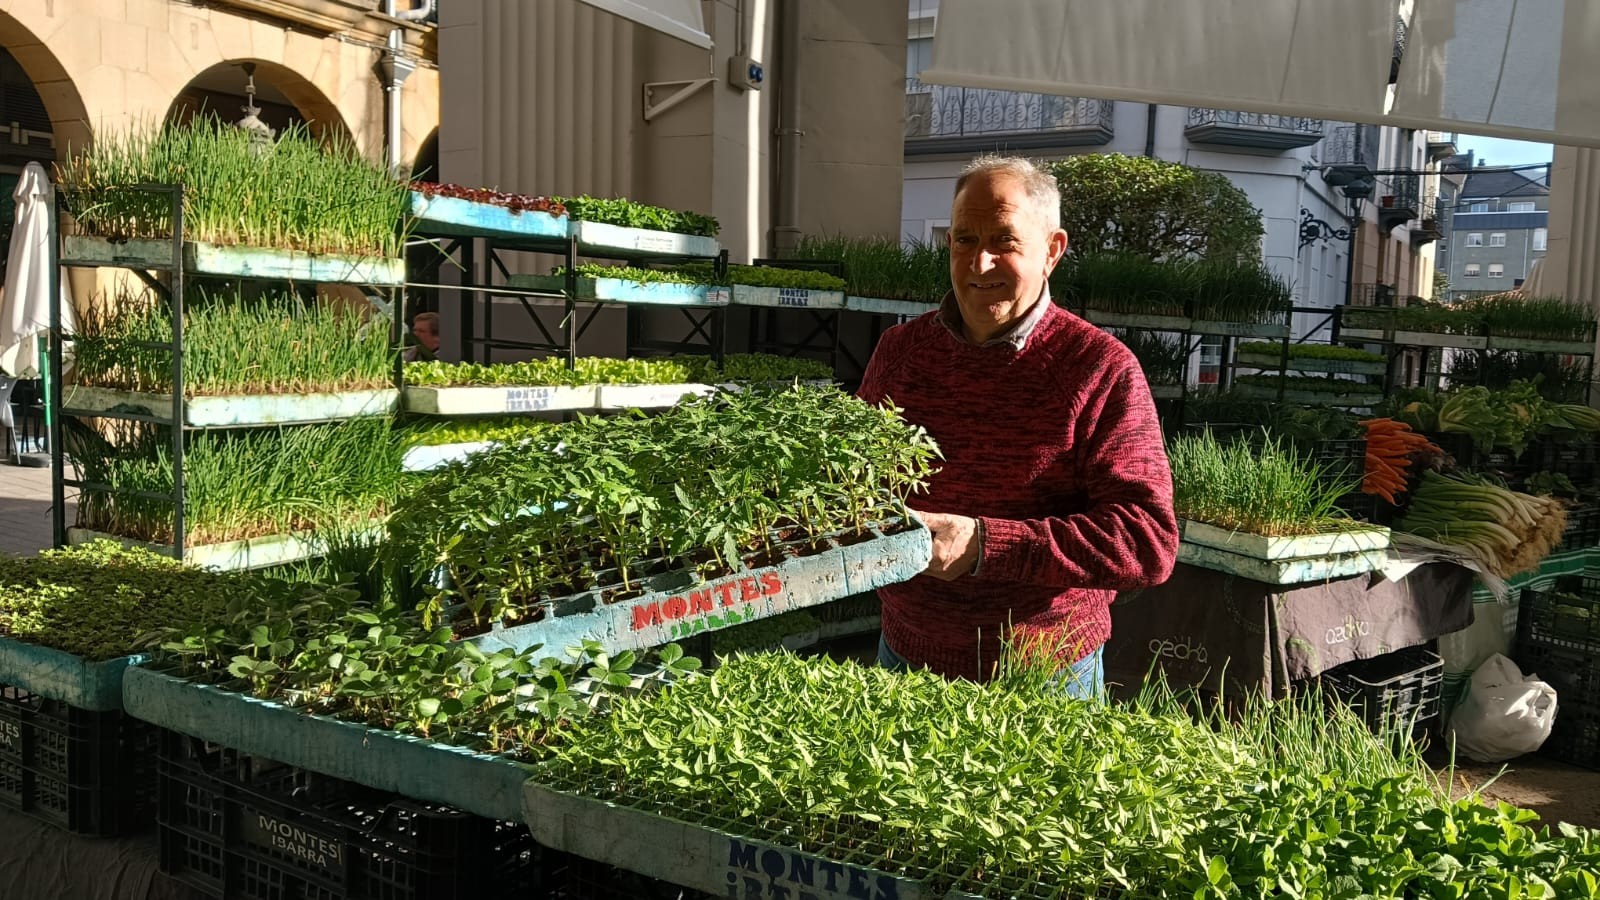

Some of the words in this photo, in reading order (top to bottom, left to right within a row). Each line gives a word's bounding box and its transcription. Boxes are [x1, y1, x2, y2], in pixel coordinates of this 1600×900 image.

[507, 388, 549, 400] MONTES
[631, 571, 782, 631] MONTES
[259, 815, 338, 858] MONTES
[272, 834, 327, 867] IBARRA
[728, 838, 899, 900] MONTES
